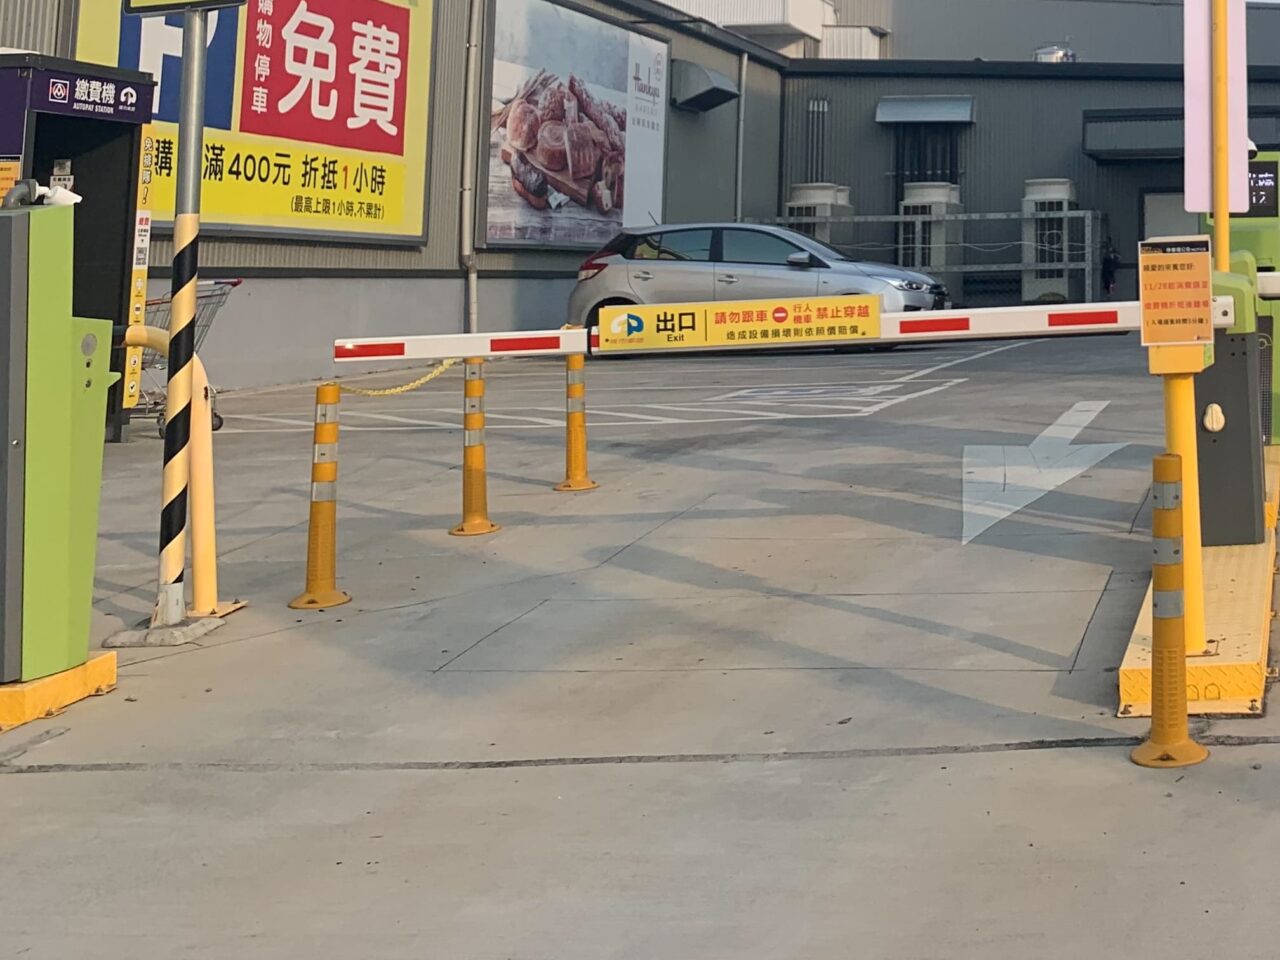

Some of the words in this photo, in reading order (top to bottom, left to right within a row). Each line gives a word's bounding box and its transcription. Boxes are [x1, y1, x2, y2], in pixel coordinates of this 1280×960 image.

[75, 78, 115, 104] 繳費機
[73, 102, 94, 112] AUTOPAY
[95, 105, 114, 115] STATION
[301, 153, 387, 196] 折抵1小時
[714, 309, 768, 324] 請勿跟車
[793, 304, 813, 314] 行人
[816, 304, 871, 319] 禁止穿越
[655, 311, 696, 333] 出口
[793, 314, 813, 325] 機車
[666, 334, 685, 342] Exit
